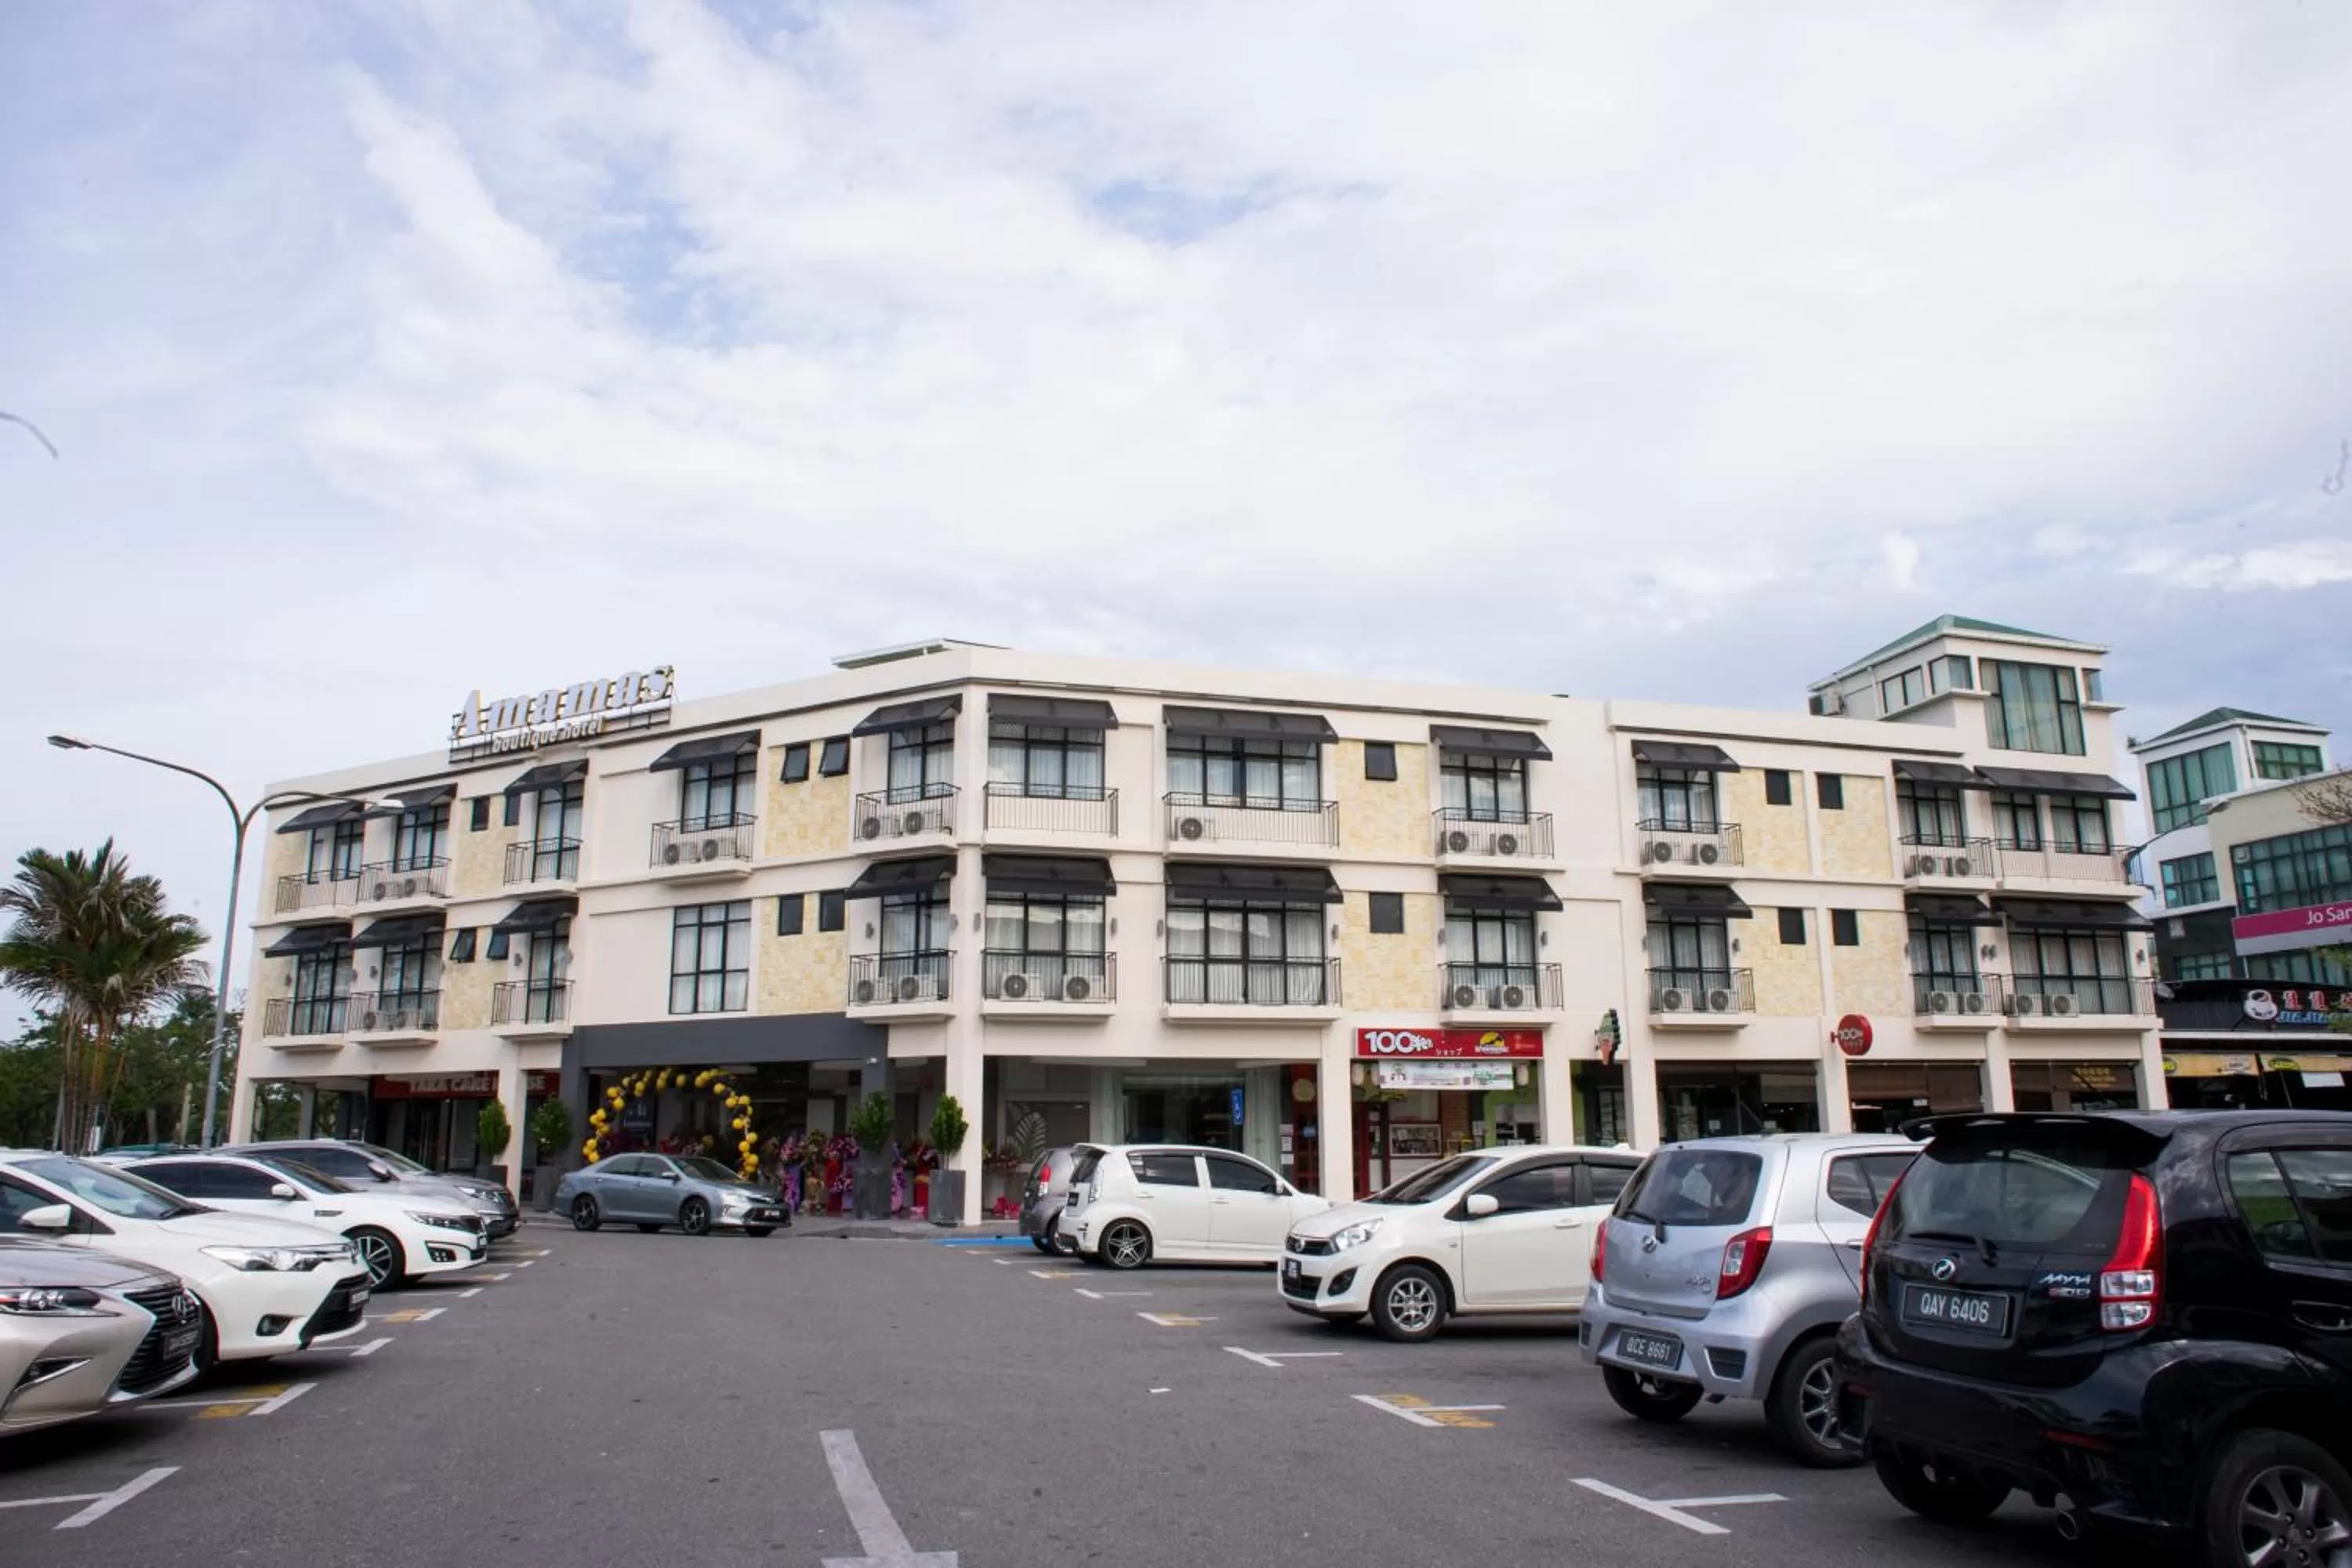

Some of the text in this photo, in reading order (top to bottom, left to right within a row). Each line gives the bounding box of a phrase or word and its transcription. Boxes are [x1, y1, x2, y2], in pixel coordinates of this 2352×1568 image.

[2307, 909, 2323, 925] Jo
[1920, 1293, 1989, 1323] QAY 6406
